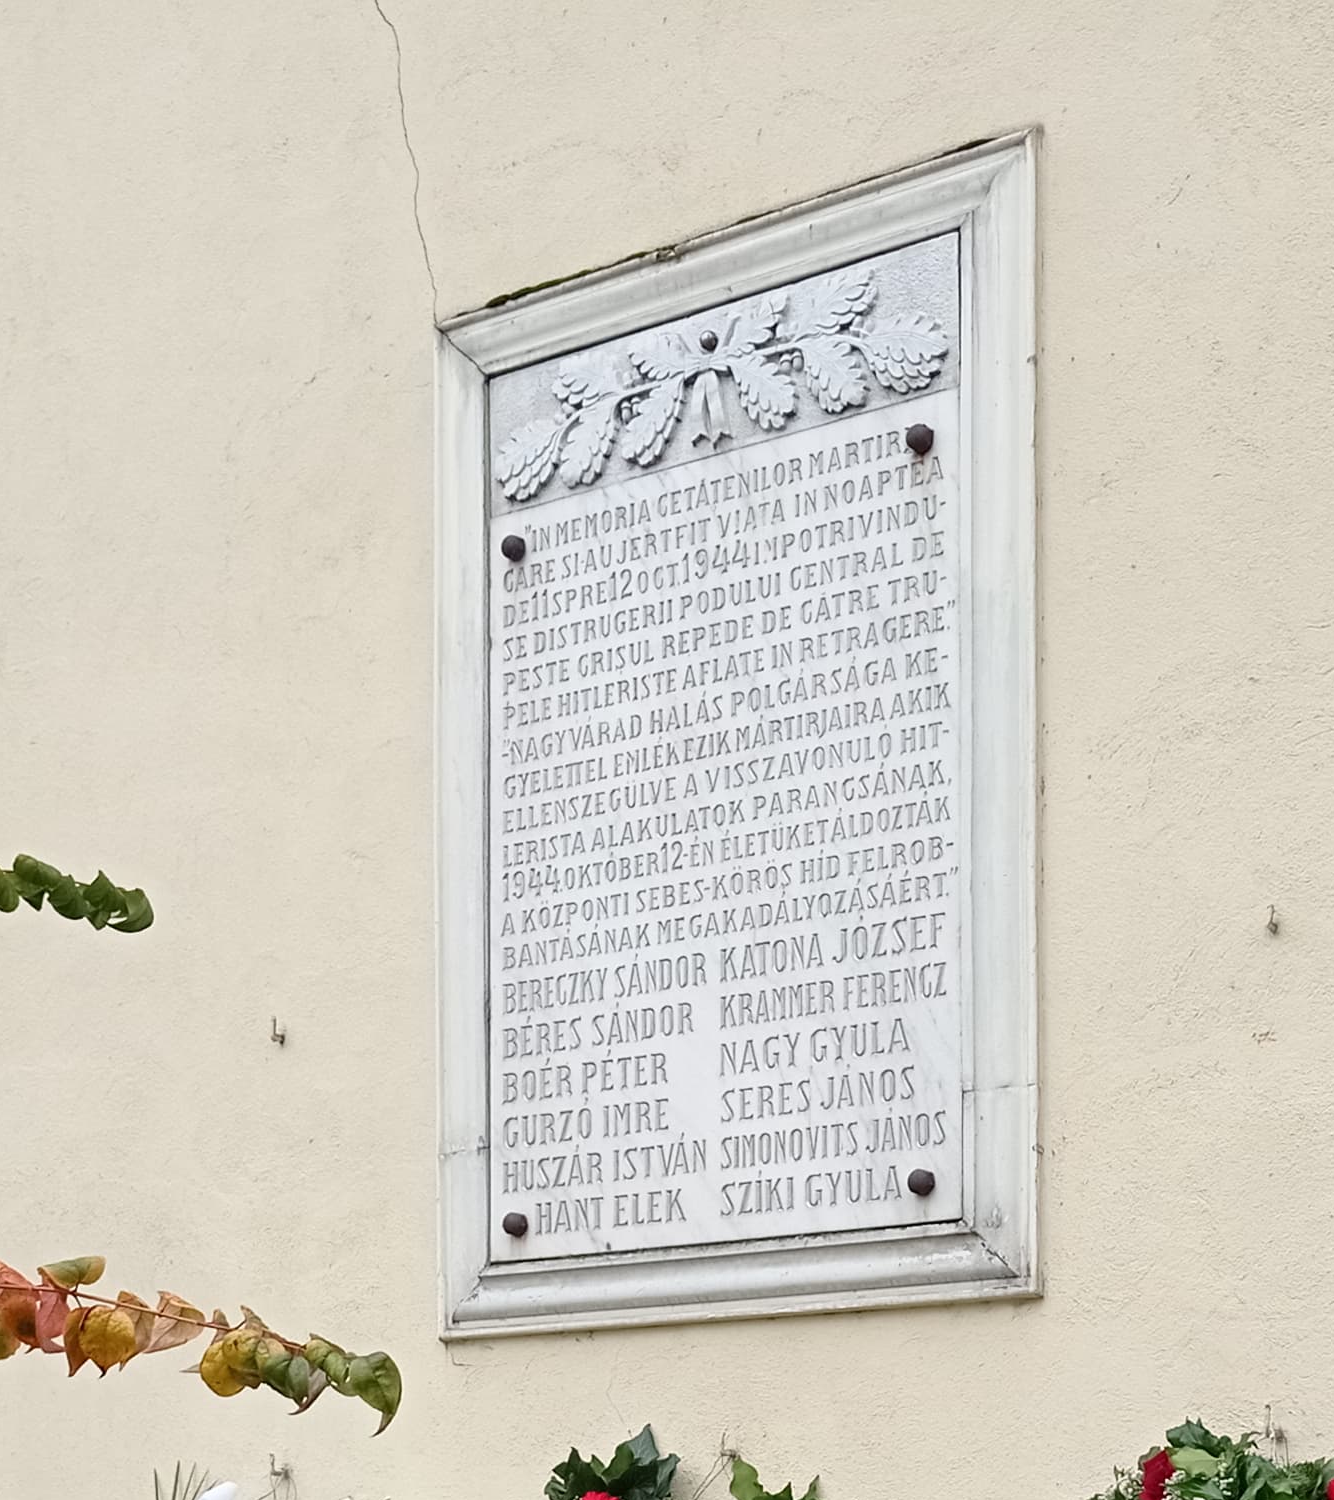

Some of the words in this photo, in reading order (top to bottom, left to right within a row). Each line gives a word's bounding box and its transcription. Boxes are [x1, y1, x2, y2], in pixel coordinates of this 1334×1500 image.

[555, 499, 651, 547] MEMORIA
[808, 428, 912, 479] MARTIR
[503, 559, 555, 593] CARE
[616, 517, 711, 565] JERTFIT
[824, 456, 944, 512] NOAPTEA
[503, 634, 527, 662] SE
[533, 599, 673, 655] DISTRUGERII
[679, 571, 781, 620] PODULUI
[790, 542, 904, 591] CENTRAL
[912, 530, 945, 563] DE
[503, 658, 570, 697] PESTE
[662, 614, 754, 659] REPEDE
[762, 605, 792, 635] DE
[888, 570, 947, 606] TRU-
[503, 696, 552, 730] PELE
[682, 648, 765, 690] AFLATE
[650, 691, 723, 734] HALÁS
[730, 655, 897, 718] POLGÁRSÁGA
[905, 647, 949, 680] KE-
[504, 757, 607, 799] GYELETTEL
[613, 729, 731, 778] EMLÉKEZIK
[890, 682, 952, 720] AKIK
[502, 776, 677, 835] ELLENSZEGÜLVE
[683, 773, 699, 799] A
[705, 724, 892, 793] VISSZAVONULÓ
[900, 721, 950, 755] HIT-
[503, 831, 586, 868] LERISTA
[591, 799, 745, 852] ALAKULATOK
[564, 851, 659, 890] OKTÓBER
[720, 819, 829, 863] ÉLETÜKET
[830, 790, 951, 842] ÁLDOZTÁK
[501, 912, 515, 937] A
[521, 892, 629, 934] KÖZPONTI
[800, 849, 840, 884] HÍD
[847, 836, 954, 877] FELROB-
[502, 922, 651, 971] BANTÁSÁNAK
[719, 933, 824, 984] KATONA
[832, 912, 946, 964] JÓZSEF
[502, 967, 607, 1016] BERECZKY
[614, 952, 707, 999] SÁNDOR
[719, 979, 835, 1031] KRAMMER
[842, 961, 947, 1011] FERENCZ
[502, 1015, 582, 1060] BÉRES
[592, 1001, 694, 1047] SÁNDOR
[719, 1031, 801, 1078] NAGY
[810, 1017, 911, 1063] GYULA
[502, 1057, 572, 1105] BOÉR
[581, 1049, 668, 1094] PÉTER
[720, 1078, 811, 1123] SERES
[820, 1063, 915, 1110] JÁNOS
[503, 1096, 592, 1149] GURZÓ
[602, 1098, 669, 1138] IMRE
[720, 1121, 858, 1170] SIMONOVITS
[865, 1107, 946, 1153] JÁNOS
[502, 1144, 603, 1194] HUSZÁR
[613, 1132, 706, 1182] ISTVÁN
[720, 1170, 794, 1216] SZÍKI
[805, 1165, 902, 1208] GYULA
[535, 1196, 603, 1235] HANT
[612, 1188, 687, 1229] ELEK
